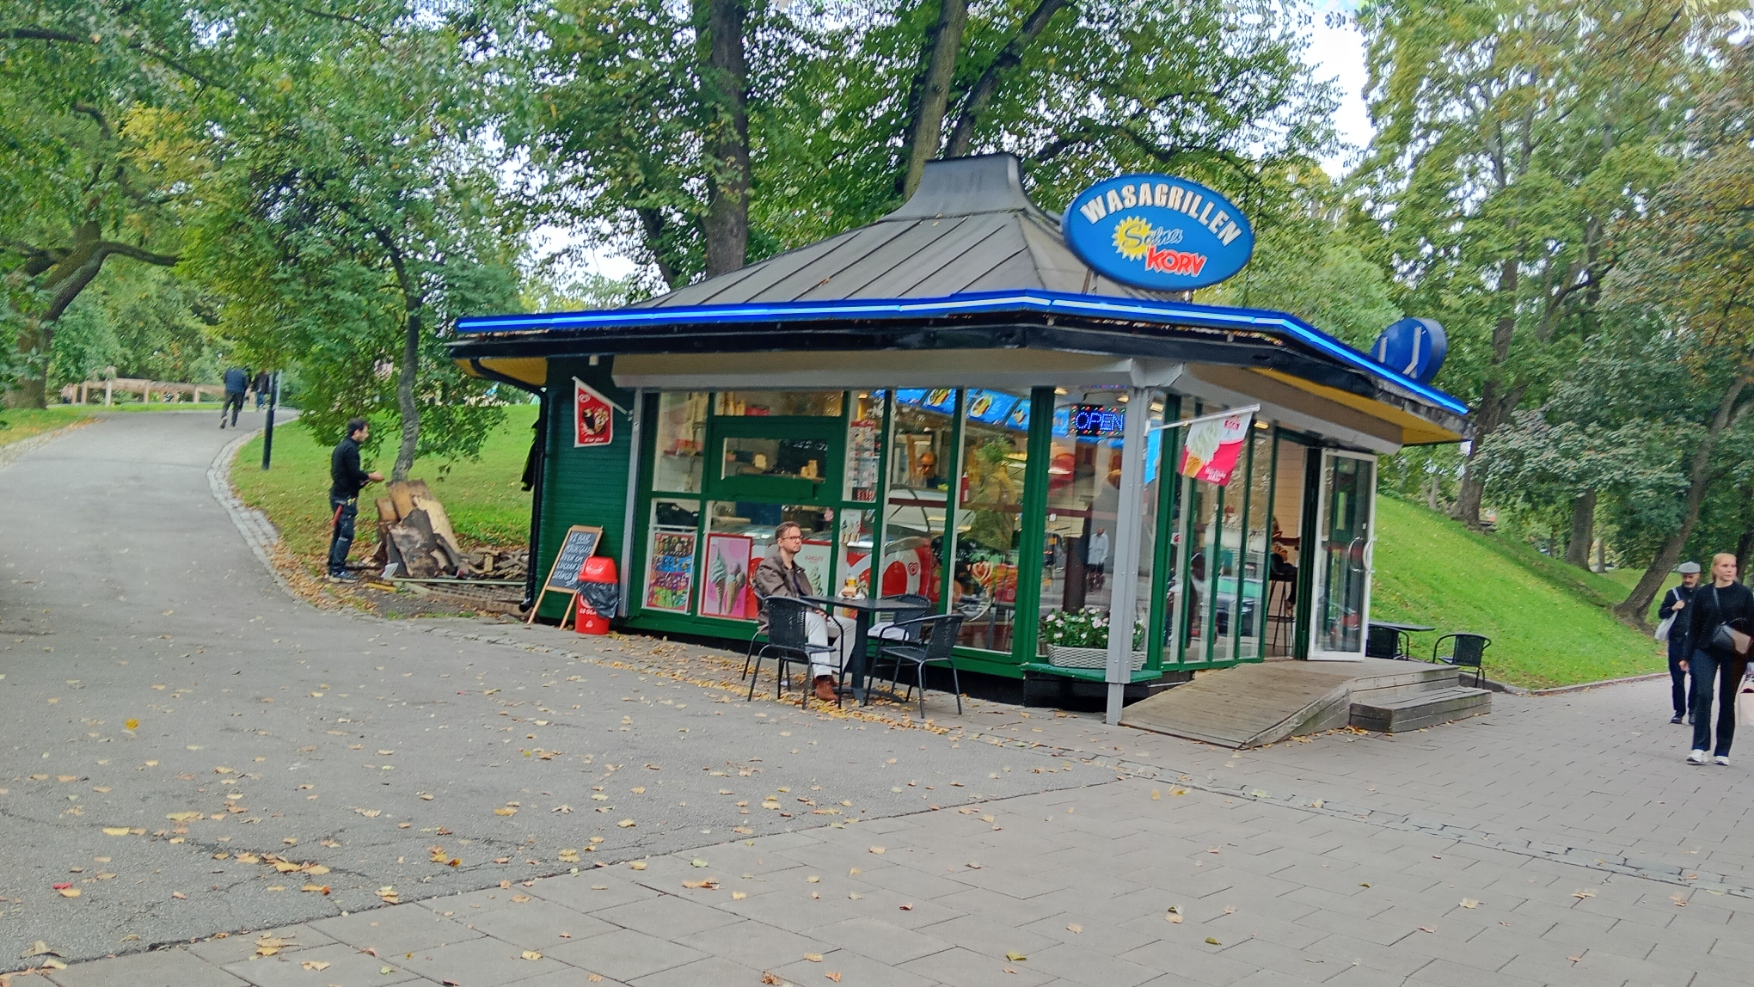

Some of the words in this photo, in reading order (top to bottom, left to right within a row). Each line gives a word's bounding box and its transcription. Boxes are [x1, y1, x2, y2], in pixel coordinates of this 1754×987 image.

[1079, 182, 1243, 247] WASAGRILLEN
[1145, 245, 1207, 278] KORV
[1075, 411, 1123, 432] OPEN
